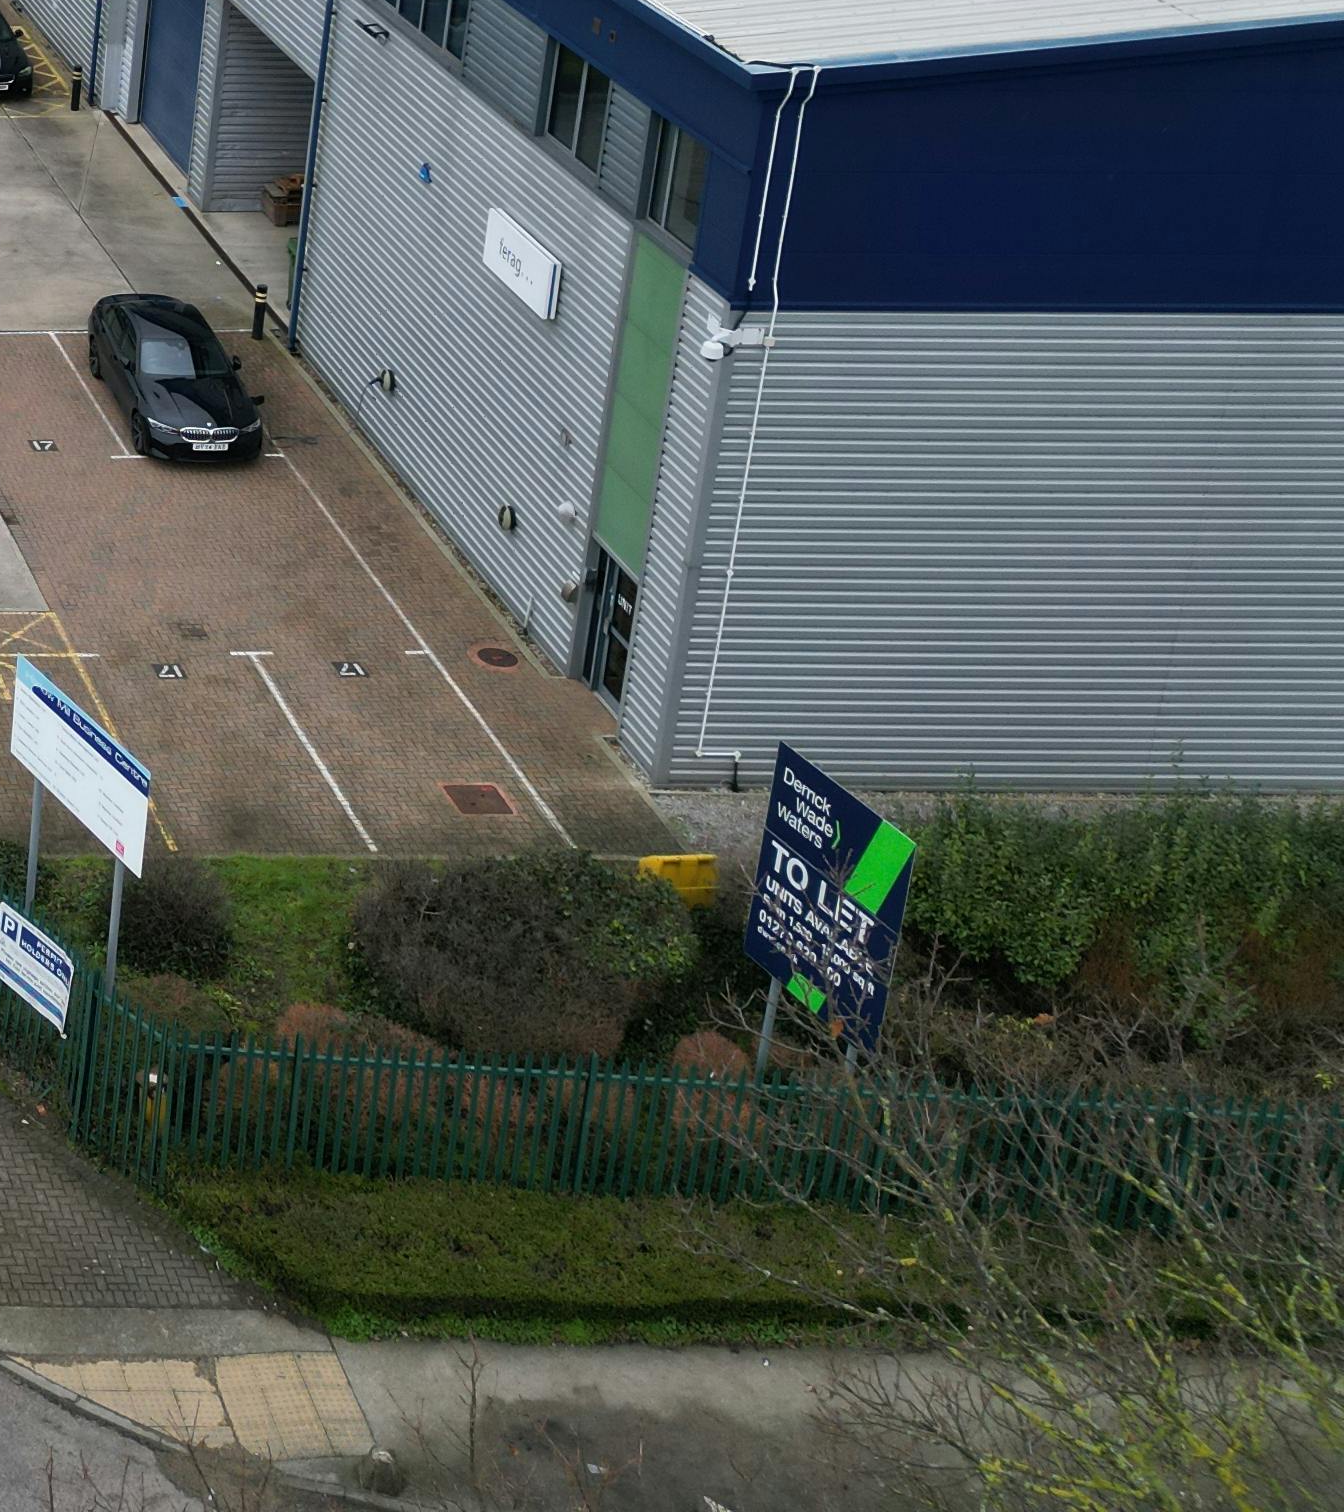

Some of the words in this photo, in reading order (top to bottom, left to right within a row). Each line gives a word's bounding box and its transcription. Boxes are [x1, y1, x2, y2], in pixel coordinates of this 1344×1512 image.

[72, 711, 113, 756] Business
[114, 751, 148, 788] Centre
[783, 766, 832, 817] Derrick
[777, 801, 823, 849] Waters
[796, 796, 834, 838] Wade
[765, 875, 803, 915] UNITS
[771, 839, 809, 891] TO
[817, 879, 875, 944] LET
[2, 914, 17, 935] P
[21, 939, 55, 972] HOLDERS
[36, 940, 63, 965] PERMIT
